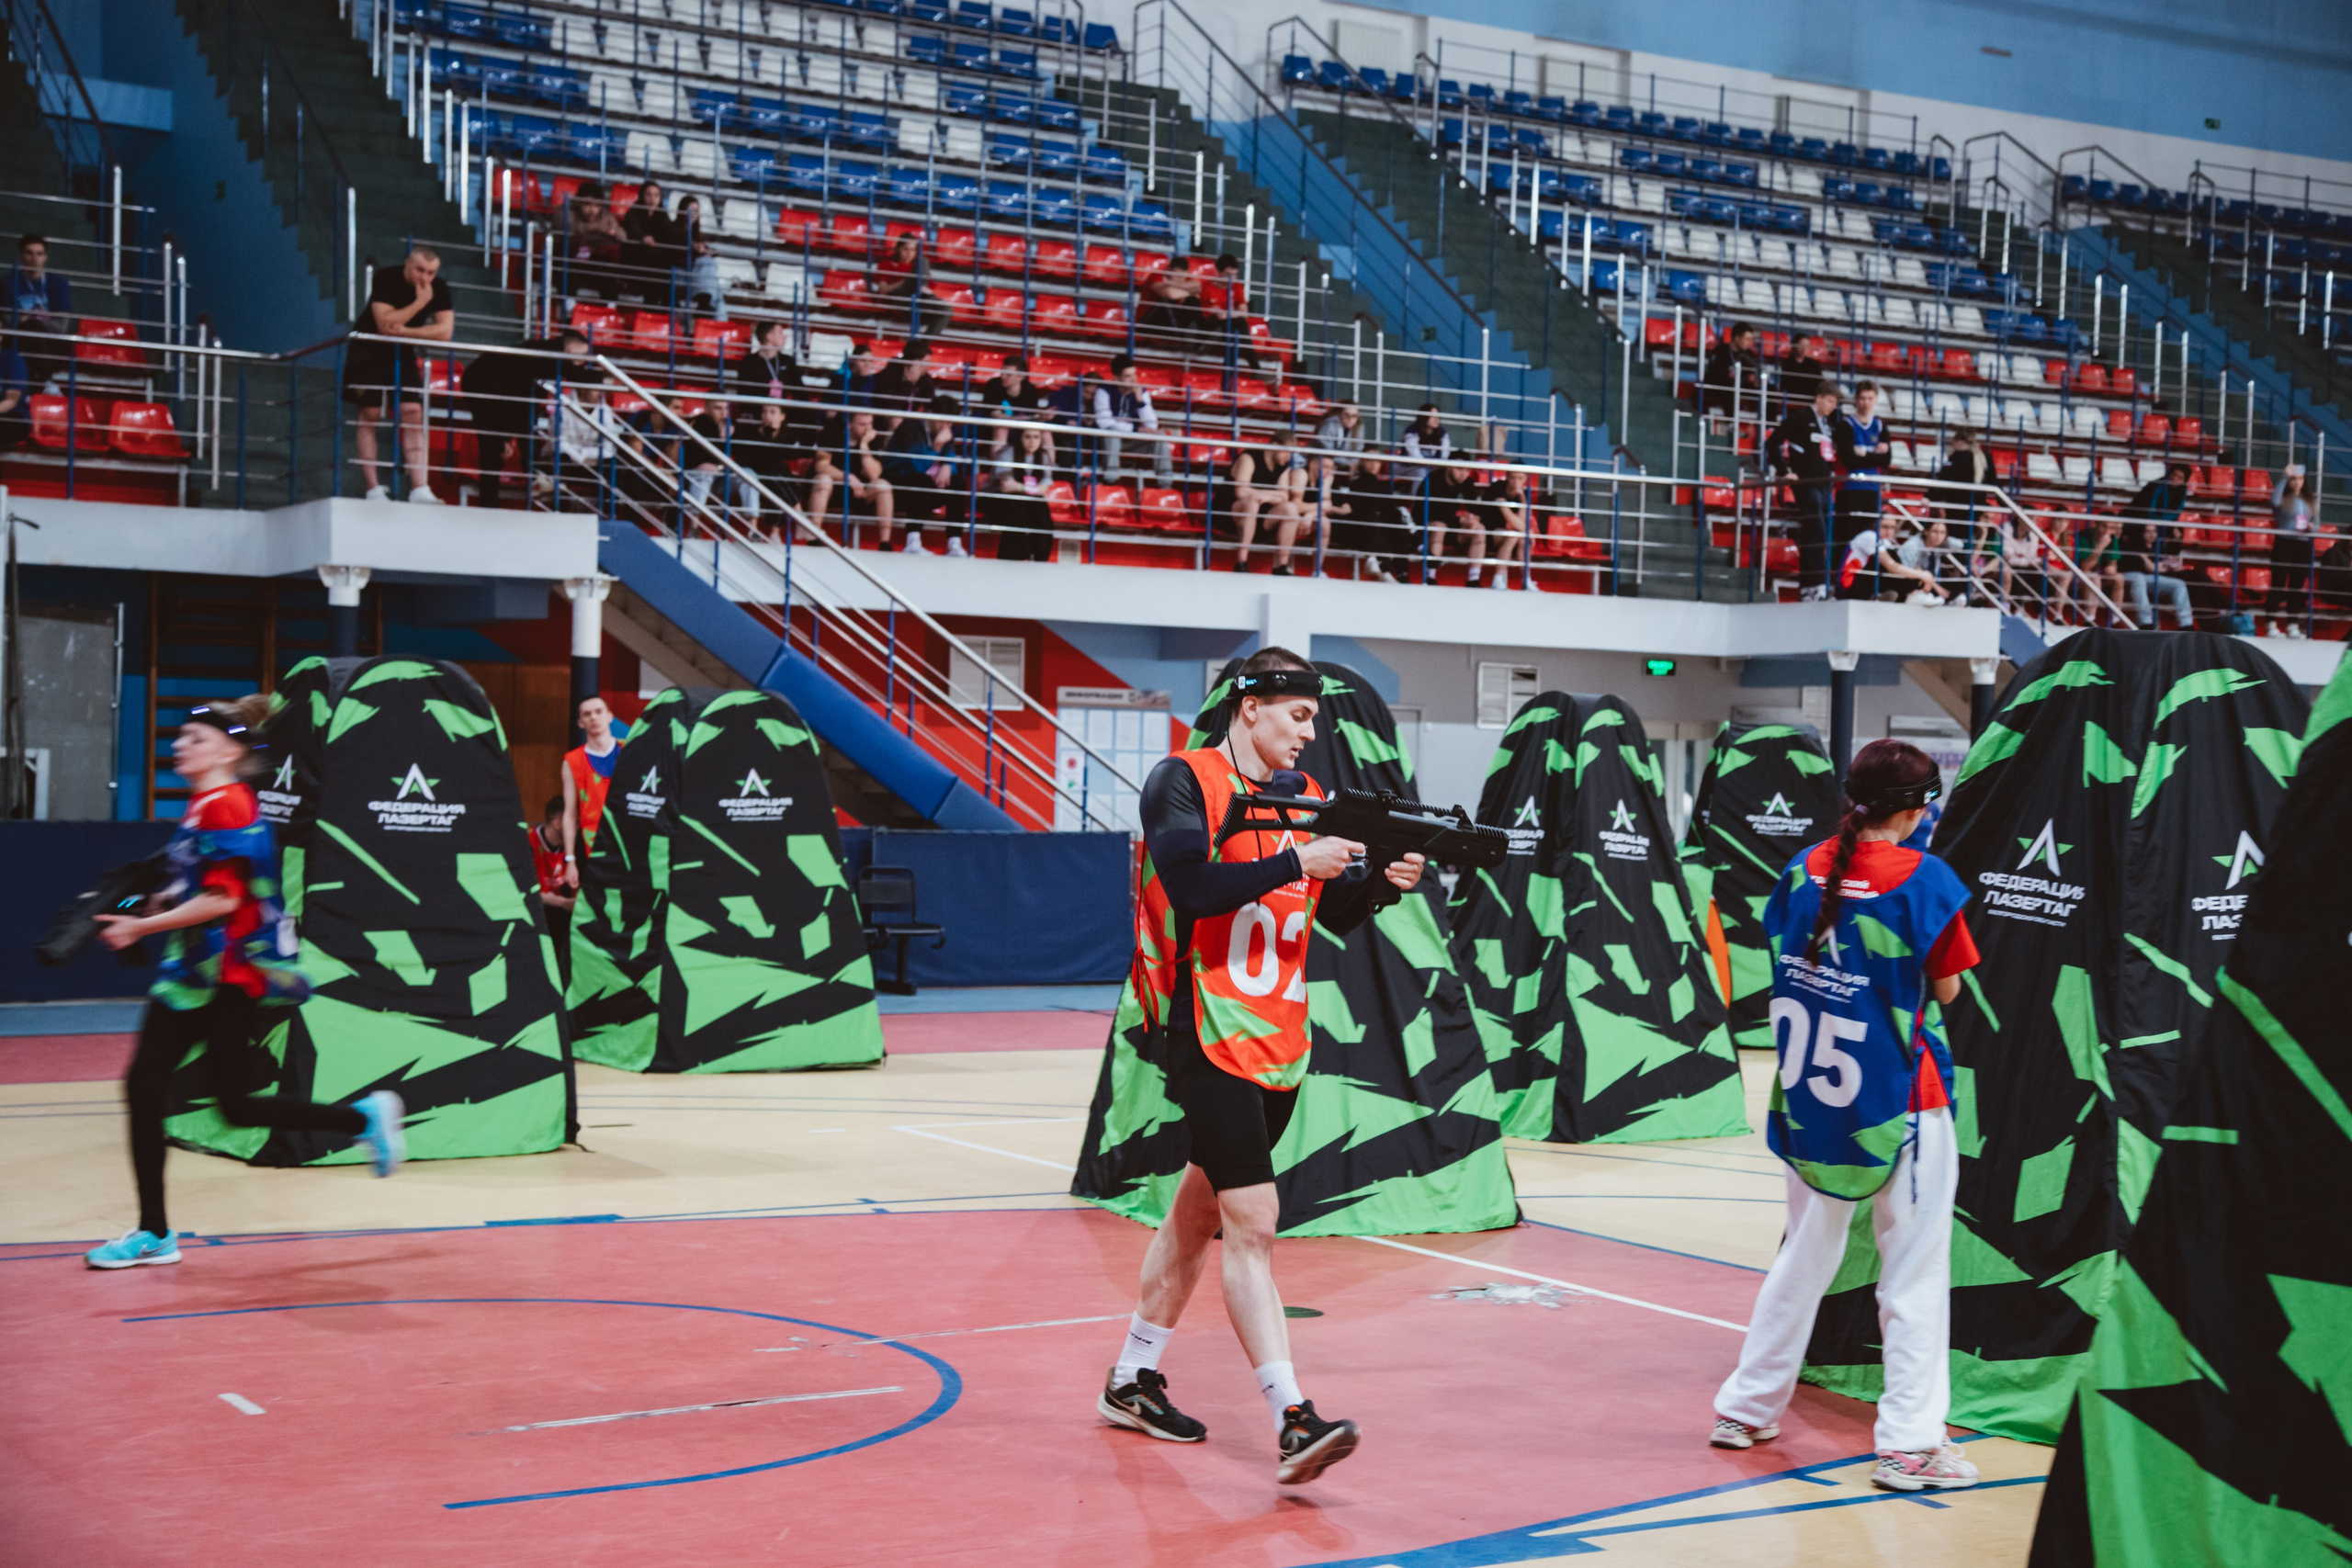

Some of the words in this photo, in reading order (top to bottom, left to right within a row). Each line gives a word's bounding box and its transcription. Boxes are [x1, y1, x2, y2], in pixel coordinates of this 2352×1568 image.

[368, 801, 466, 814] ФЕДЕРАЦИЯ
[378, 813, 458, 826] ЛАЗЕРТАГ
[1983, 890, 2078, 917] ЛАЗЕРТАГ
[1769, 997, 1869, 1108] 05
